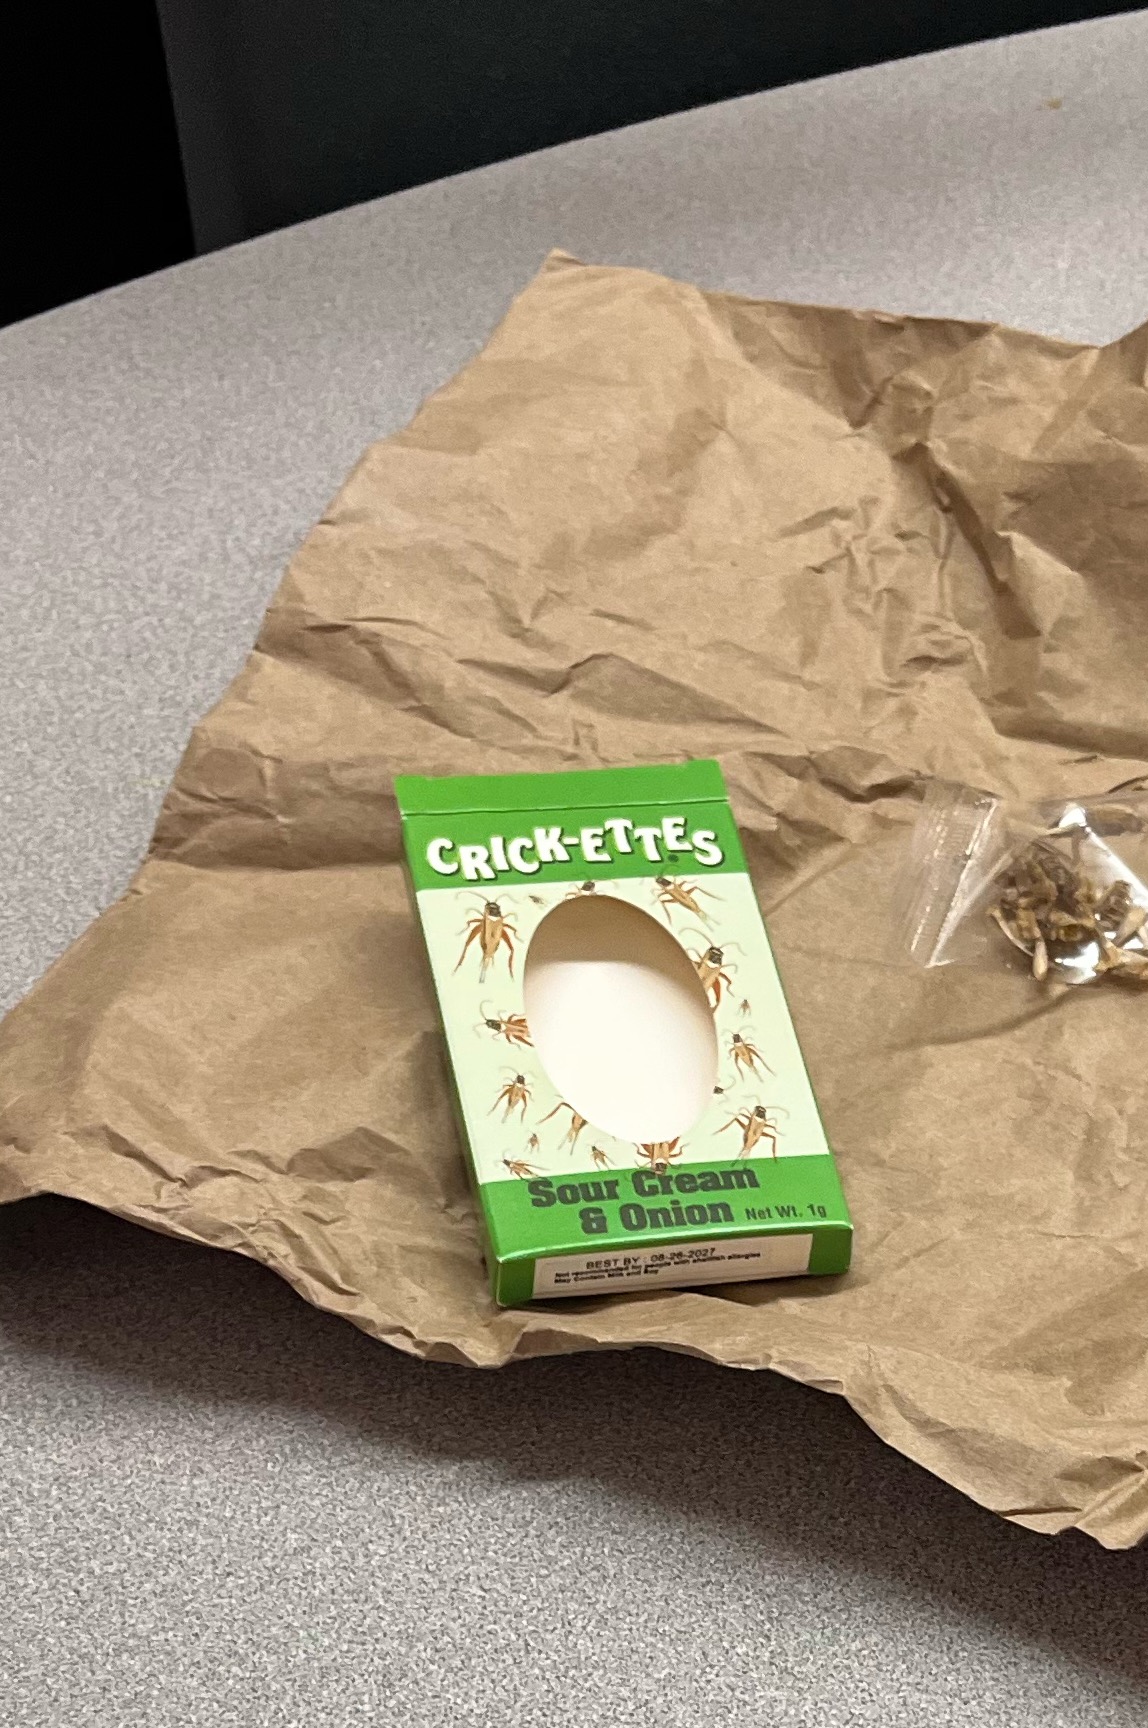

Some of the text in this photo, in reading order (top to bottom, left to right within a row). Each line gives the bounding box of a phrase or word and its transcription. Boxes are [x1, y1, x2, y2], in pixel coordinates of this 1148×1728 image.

[426, 816, 725, 881] CRICK-ETTES
[527, 1168, 760, 1208] Sour Cream
[578, 1199, 734, 1235] & Onion
[745, 1203, 828, 1222] Net Wt. 1g
[586, 1258, 619, 1270] BEST
[623, 1256, 641, 1266] BY
[728, 1252, 761, 1260] allergies
